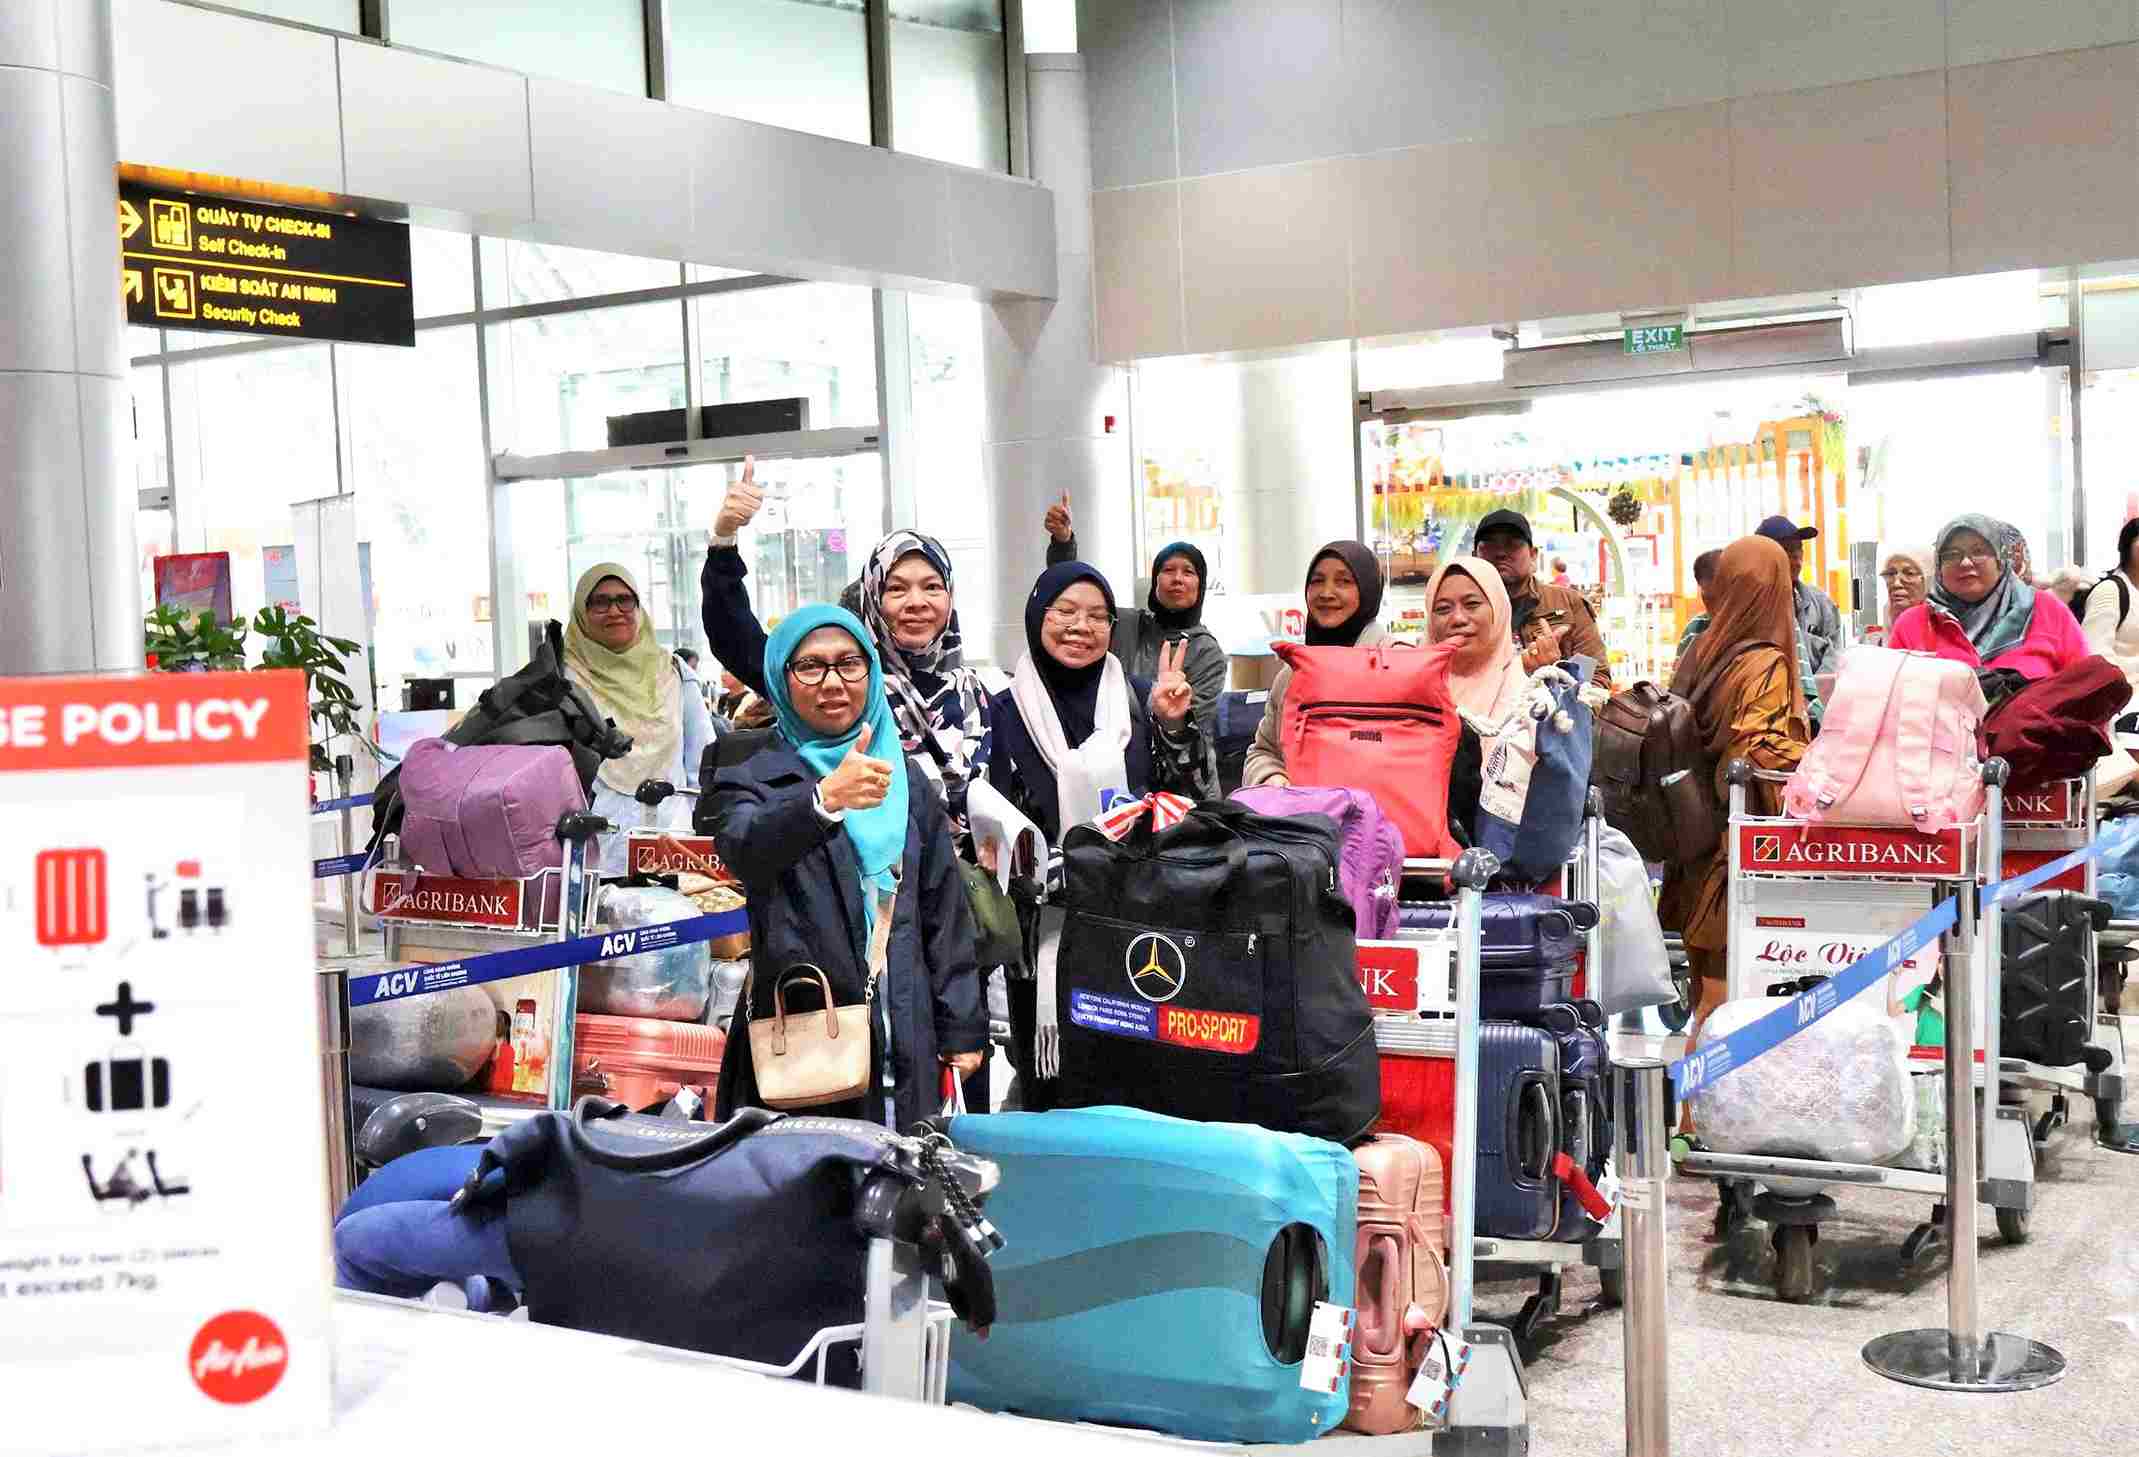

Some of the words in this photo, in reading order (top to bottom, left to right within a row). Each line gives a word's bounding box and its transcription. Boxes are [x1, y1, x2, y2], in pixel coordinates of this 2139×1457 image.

[265, 216, 331, 239] CHECK-IN
[199, 235, 226, 253] Self
[228, 238, 286, 260] Check-in
[281, 284, 301, 300] AN
[203, 303, 256, 326] Security
[259, 308, 301, 327] Check
[1631, 327, 1676, 342] EXIT
[0, 705, 47, 748] E
[62, 698, 270, 747] POLICY
[658, 852, 727, 873] AGRIB
[1785, 842, 1947, 866] AGRIBANK
[402, 890, 509, 916] AGRIBANK
[600, 931, 636, 957] ACV
[374, 970, 419, 999] ACV
[1168, 1010, 1249, 1043] PRO-SPORT
[1681, 1055, 1706, 1093] ACV
[16, 1275, 104, 1297] exceed
